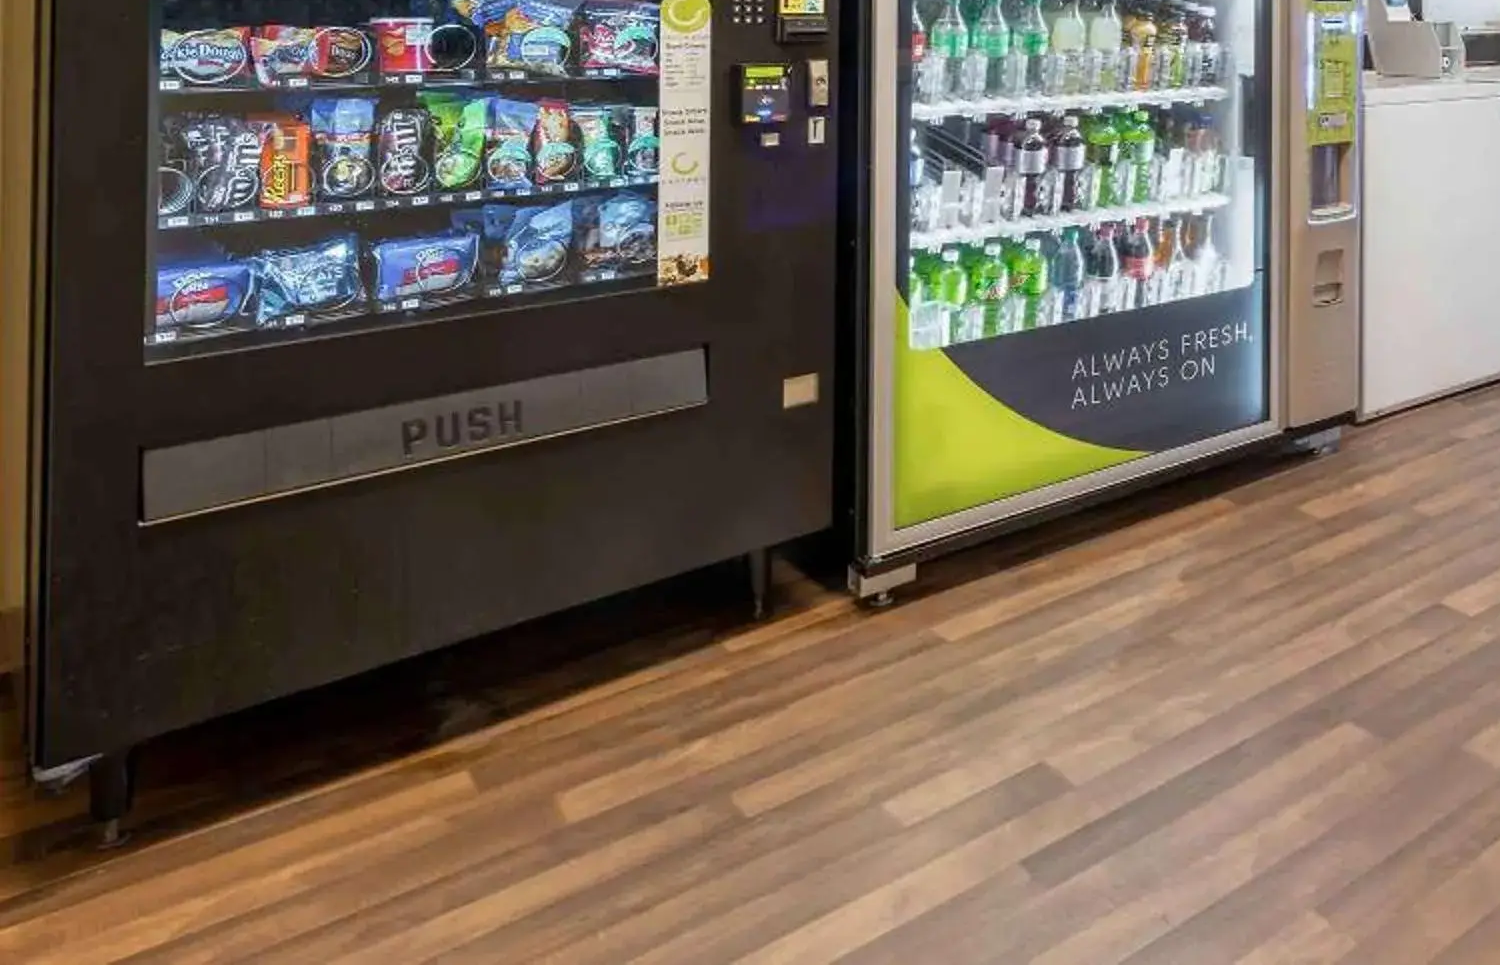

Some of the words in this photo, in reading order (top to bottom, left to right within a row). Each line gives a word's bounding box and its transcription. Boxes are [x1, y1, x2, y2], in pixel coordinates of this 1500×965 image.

[1071, 339, 1169, 380] ALWAYS
[1071, 366, 1169, 409] ALWAYS
[1180, 354, 1216, 381] ON
[401, 400, 524, 456] PUSH
